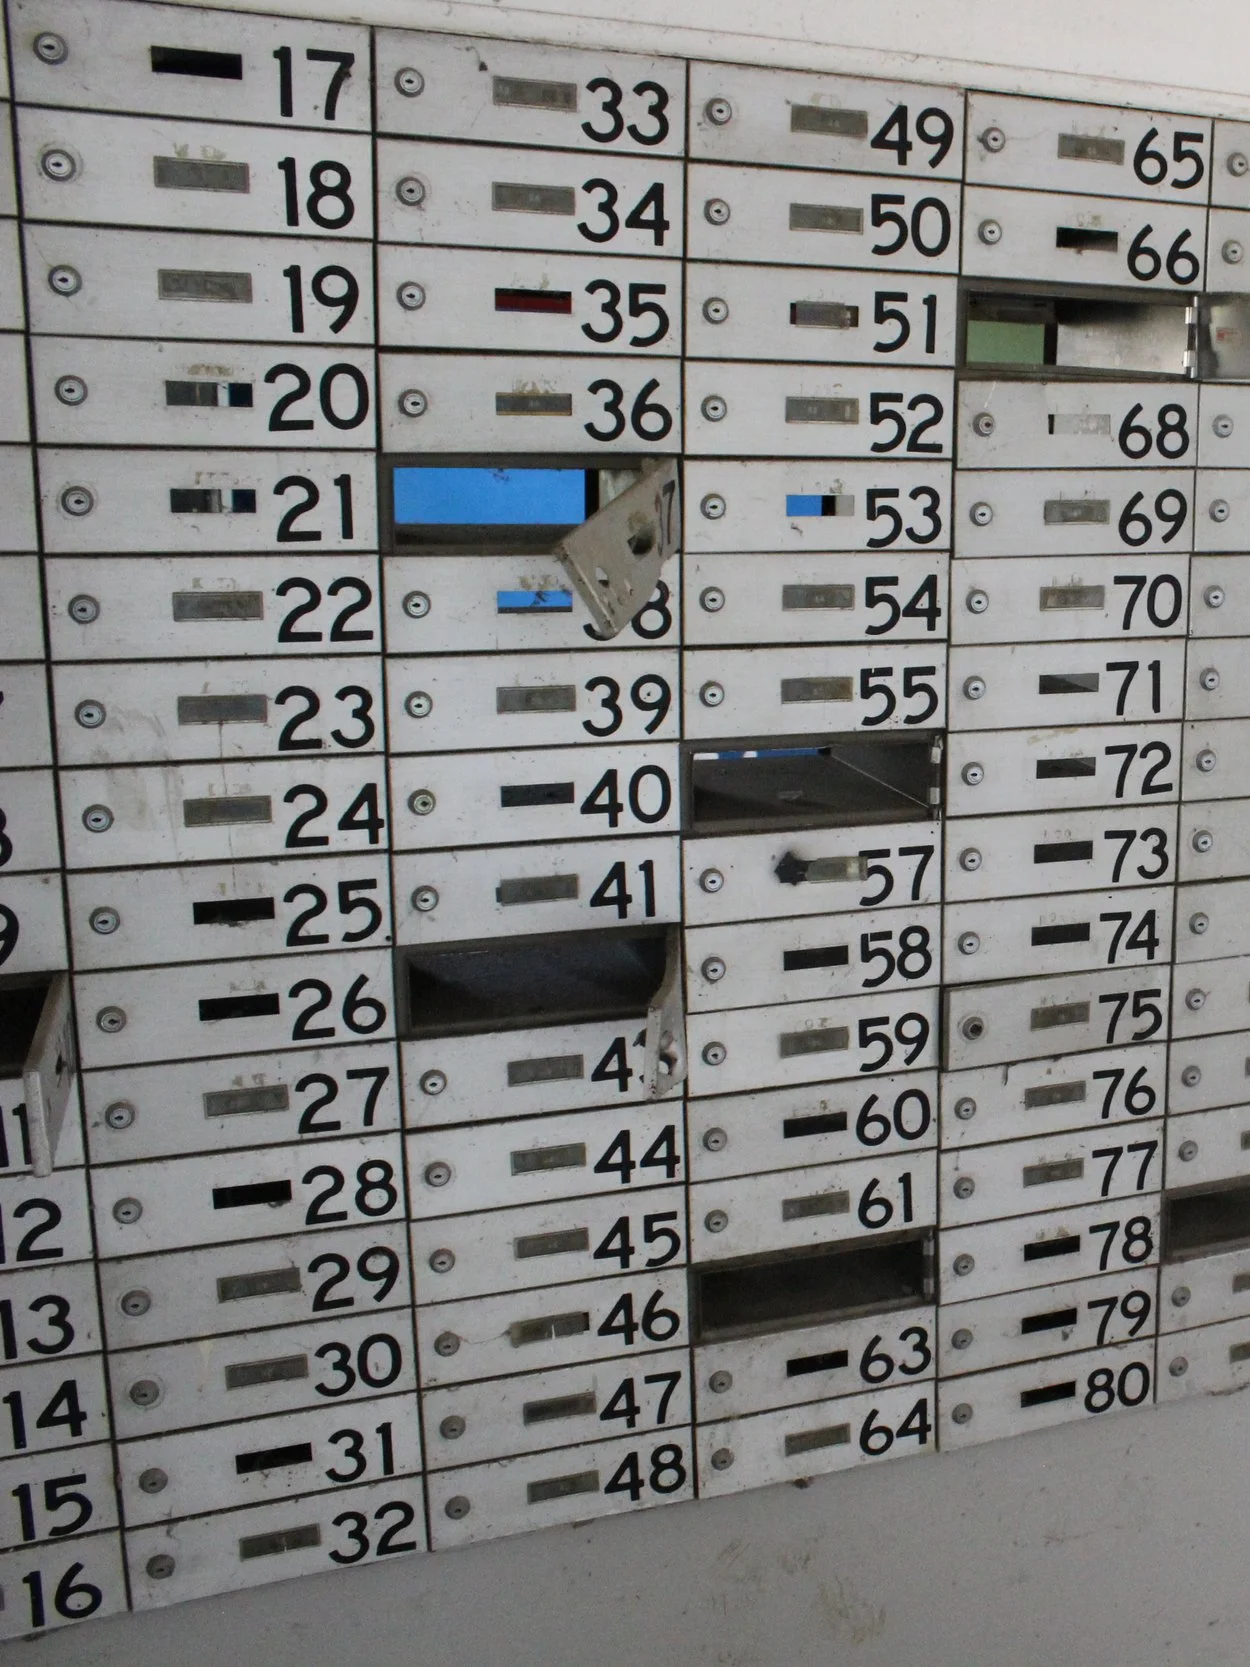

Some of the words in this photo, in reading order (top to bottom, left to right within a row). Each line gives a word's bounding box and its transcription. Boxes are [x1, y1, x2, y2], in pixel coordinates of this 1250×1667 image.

[273, 46, 355, 120] 17
[581, 78, 669, 145] 33
[871, 105, 954, 168] 49
[1134, 128, 1204, 189] 65
[278, 157, 354, 229] 18
[577, 178, 669, 246] 34
[871, 194, 951, 257] 50
[1127, 224, 1199, 285] 66
[283, 265, 359, 334] 19
[581, 279, 669, 347] 35
[873, 291, 936, 354] 51
[264, 363, 369, 431] 20
[584, 379, 672, 442] 36
[1119, 403, 1189, 459] 68
[273, 474, 353, 542] 21
[867, 486, 942, 548] 53
[1119, 489, 1187, 546] 69
[865, 574, 941, 635] 54
[1114, 574, 1182, 630] 70
[275, 686, 375, 751] 23
[860, 666, 938, 726] 55
[580, 765, 671, 828] 40
[1105, 741, 1173, 798] 72
[284, 783, 384, 848] 24
[1104, 828, 1169, 883] 73
[283, 879, 382, 947] 25
[590, 860, 655, 919] 41
[861, 925, 932, 988] 58
[1100, 910, 1159, 964] 74
[288, 974, 386, 1040] 26
[1099, 989, 1162, 1045] 75
[859, 1012, 929, 1072] 59
[856, 1089, 930, 1146] 60
[1093, 1066, 1156, 1119] 76
[594, 1125, 680, 1184] 44
[1092, 1140, 1158, 1197] 77
[302, 1160, 397, 1225] 28
[858, 1172, 913, 1229] 61
[593, 1211, 681, 1269] 45
[1089, 1216, 1154, 1271] 78
[308, 1246, 399, 1312] 29
[598, 1289, 680, 1345] 46
[1087, 1290, 1152, 1345] 79
[315, 1333, 402, 1397] 30
[860, 1327, 931, 1384] 63
[3, 1380, 87, 1449] 14
[600, 1371, 681, 1428] 47
[1084, 1361, 1151, 1413] 80
[325, 1422, 394, 1483] 31
[860, 1398, 931, 1456] 64
[604, 1444, 686, 1501] 48
[12, 1474, 93, 1541] 15
[329, 1500, 416, 1564] 32
[23, 1562, 102, 1627] 16
